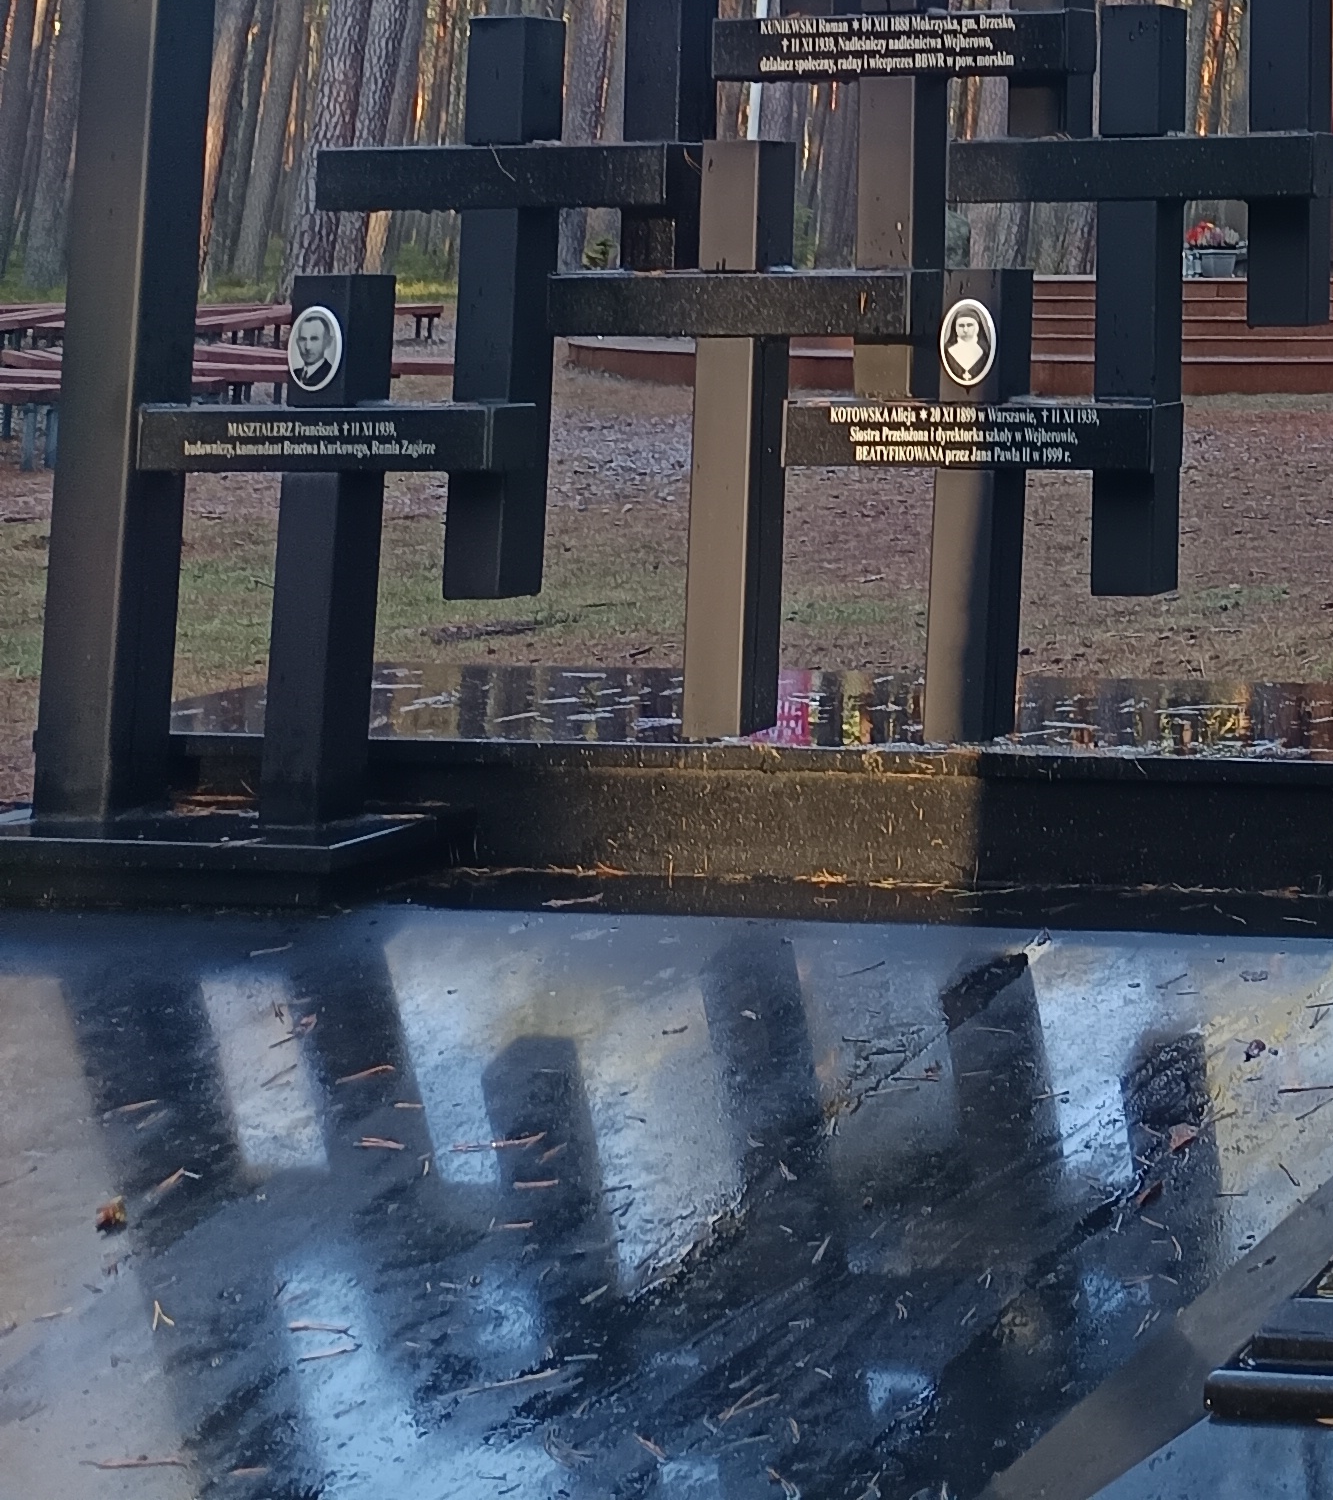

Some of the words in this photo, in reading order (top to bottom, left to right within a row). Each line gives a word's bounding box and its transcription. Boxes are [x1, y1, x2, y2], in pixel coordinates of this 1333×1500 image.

[760, 19, 816, 34] KUNIEWSKI
[819, 19, 848, 33] Roman
[911, 15, 960, 34] Mokrzyska,
[838, 36, 887, 54] Nadleśniczy
[888, 34, 942, 50] nadleśnictwa
[943, 34, 993, 52] Wejherowo,
[838, 54, 862, 73] radny
[869, 54, 913, 73] wiceprezes
[955, 56, 975, 71] pow.
[977, 51, 1014, 67] morskim
[830, 407, 889, 423] KOTOWSKA
[890, 407, 916, 426] Alicja
[956, 407, 976, 423] 1899
[987, 407, 1036, 426] Warszawie,
[1077, 408, 1099, 426] 1939,
[227, 422, 293, 437] MASZTALERZ
[295, 421, 339, 437] Franciszek
[375, 422, 397, 439] 1939,
[850, 426, 880, 442] Siostra
[882, 426, 929, 442] Przełożona
[935, 426, 983, 446] dyrektorka
[985, 427, 1012, 446] szkoły
[1024, 427, 1078, 447] Wejherowie,
[184, 440, 235, 459] budowniczy,
[236, 441, 282, 455] komendant
[283, 440, 318, 455] Bractwa
[320, 440, 370, 458] Kurkowego,
[372, 440, 399, 455] Rumia
[401, 439, 436, 459] Zagórze
[855, 445, 944, 461] BEATYFIKOWANA
[945, 449, 969, 465] przez
[970, 446, 991, 462] Jana
[994, 447, 1020, 462] Pawła
[1043, 447, 1062, 463] 1999
